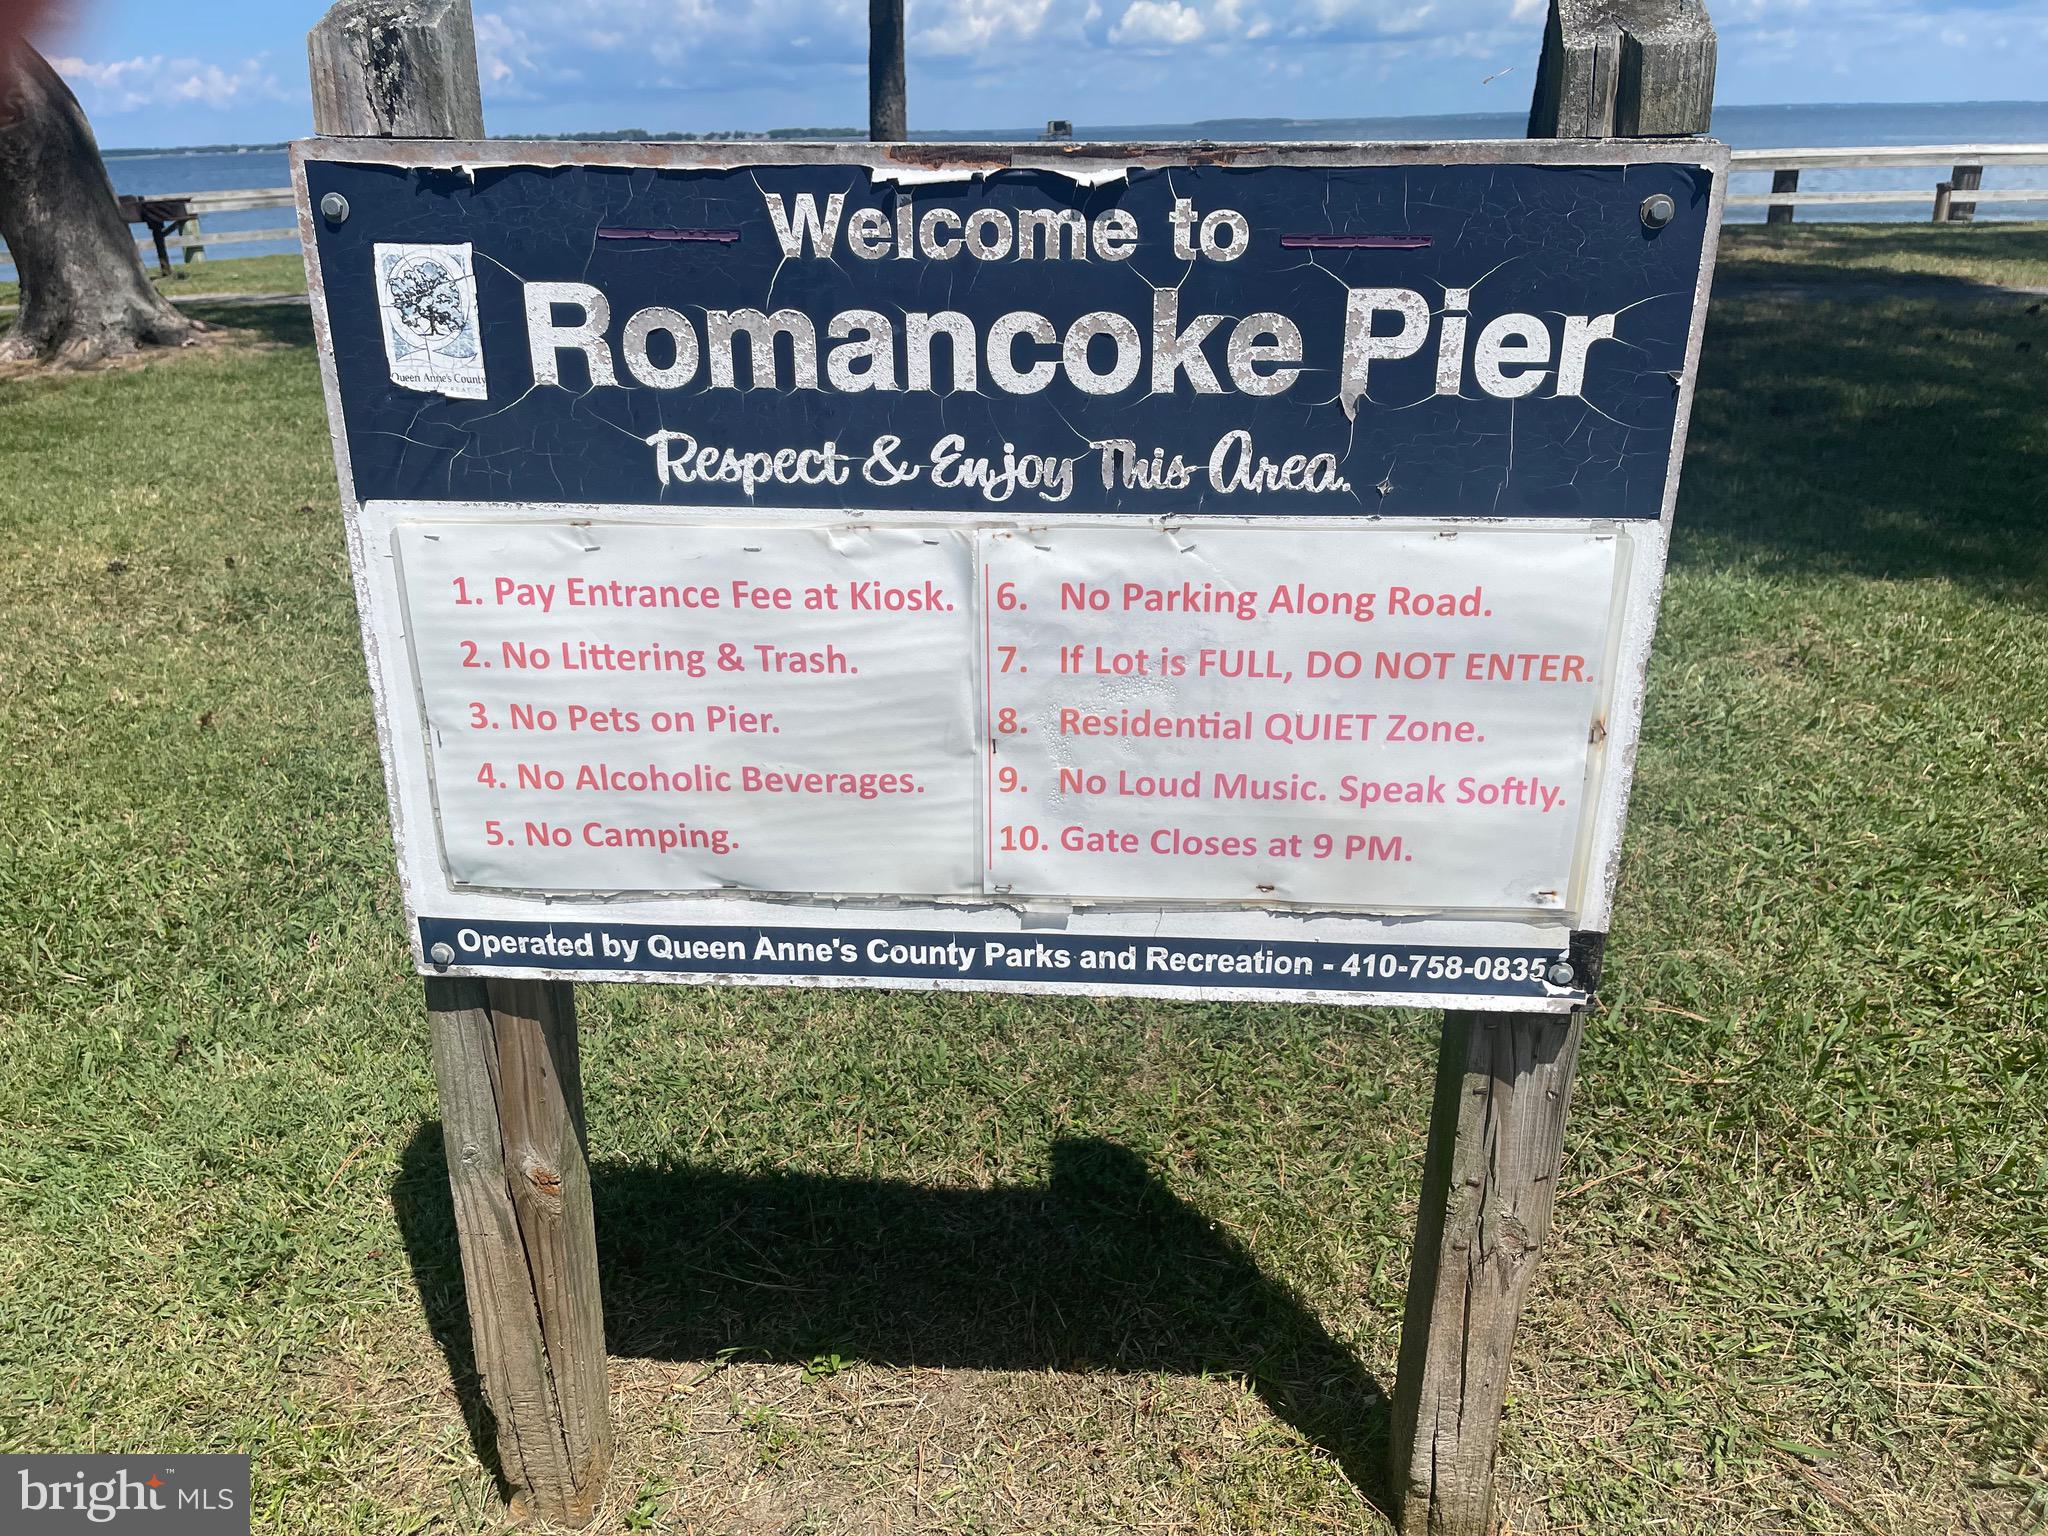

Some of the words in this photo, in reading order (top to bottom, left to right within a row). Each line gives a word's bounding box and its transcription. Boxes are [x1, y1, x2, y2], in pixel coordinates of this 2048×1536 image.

[765, 193, 1139, 261] Welcome
[1169, 197, 1250, 261] to
[523, 282, 1303, 395] Romancoke
[1339, 287, 1615, 400] Pier
[424, 373, 452, 384] Anne's
[646, 429, 849, 496] Respect
[863, 434, 919, 486] &
[930, 433, 1074, 502] Enjoy
[1090, 438, 1197, 490] This
[1208, 429, 1350, 494] Area.
[453, 576, 483, 606] 1.
[495, 577, 555, 613] Pay
[567, 577, 720, 608] Entrance
[732, 580, 792, 610] Fee
[804, 584, 837, 611] at
[850, 580, 954, 612] Kiosk.
[997, 582, 1027, 611] 6.
[1061, 581, 1110, 612] No
[1123, 581, 1257, 621] Parking
[1268, 583, 1376, 622] Along
[1388, 586, 1492, 617] Road.
[460, 640, 491, 668] 2.
[502, 641, 551, 670] No
[562, 641, 707, 678] Littering
[717, 642, 744, 672] &
[754, 644, 858, 673] Trash.
[997, 645, 1027, 672] 7.
[1060, 644, 1084, 673] If
[1095, 646, 1149, 676] Lot
[1161, 647, 1185, 677] is
[1199, 649, 1292, 684] FULL,
[1306, 650, 1362, 679] DO
[1375, 651, 1456, 680] NOT
[1465, 653, 1593, 683] ENTER.
[469, 701, 499, 730] 3.
[510, 704, 557, 731] No
[568, 704, 640, 733] Pets
[651, 711, 695, 733] on
[706, 705, 780, 733] Pier.
[998, 707, 1028, 734] 8.
[1060, 707, 1252, 740] Residential
[1265, 713, 1376, 744] QUIET
[1386, 714, 1485, 743] Zone.
[477, 763, 507, 789] 4.
[517, 763, 565, 790] No
[576, 763, 732, 792] Alcoholic
[741, 766, 924, 800] Beverages.
[999, 767, 1028, 793] 9.
[1060, 768, 1108, 794] No
[1119, 770, 1201, 799] Loud
[1213, 772, 1326, 801] Music.
[1339, 774, 1445, 810] Speak
[1456, 776, 1566, 813] Softly.
[485, 820, 514, 847] 5.
[525, 821, 572, 847] No
[582, 822, 739, 855] Camping.
[1001, 825, 1049, 852] 10.
[1060, 826, 1139, 853] Gate
[1150, 828, 1257, 857] Closes
[1268, 834, 1301, 859] at
[1314, 832, 1333, 859] 9
[1345, 835, 1412, 862] PM.
[457, 928, 593, 957] Operated
[603, 934, 640, 962] by
[648, 934, 744, 961] Queen
[752, 936, 857, 963] Anne's
[866, 938, 975, 971] County
[984, 943, 1071, 968] Parks
[1080, 947, 1136, 971] and
[1146, 946, 1312, 976] Recreation
[1341, 953, 1546, 982] 410-758-0835
